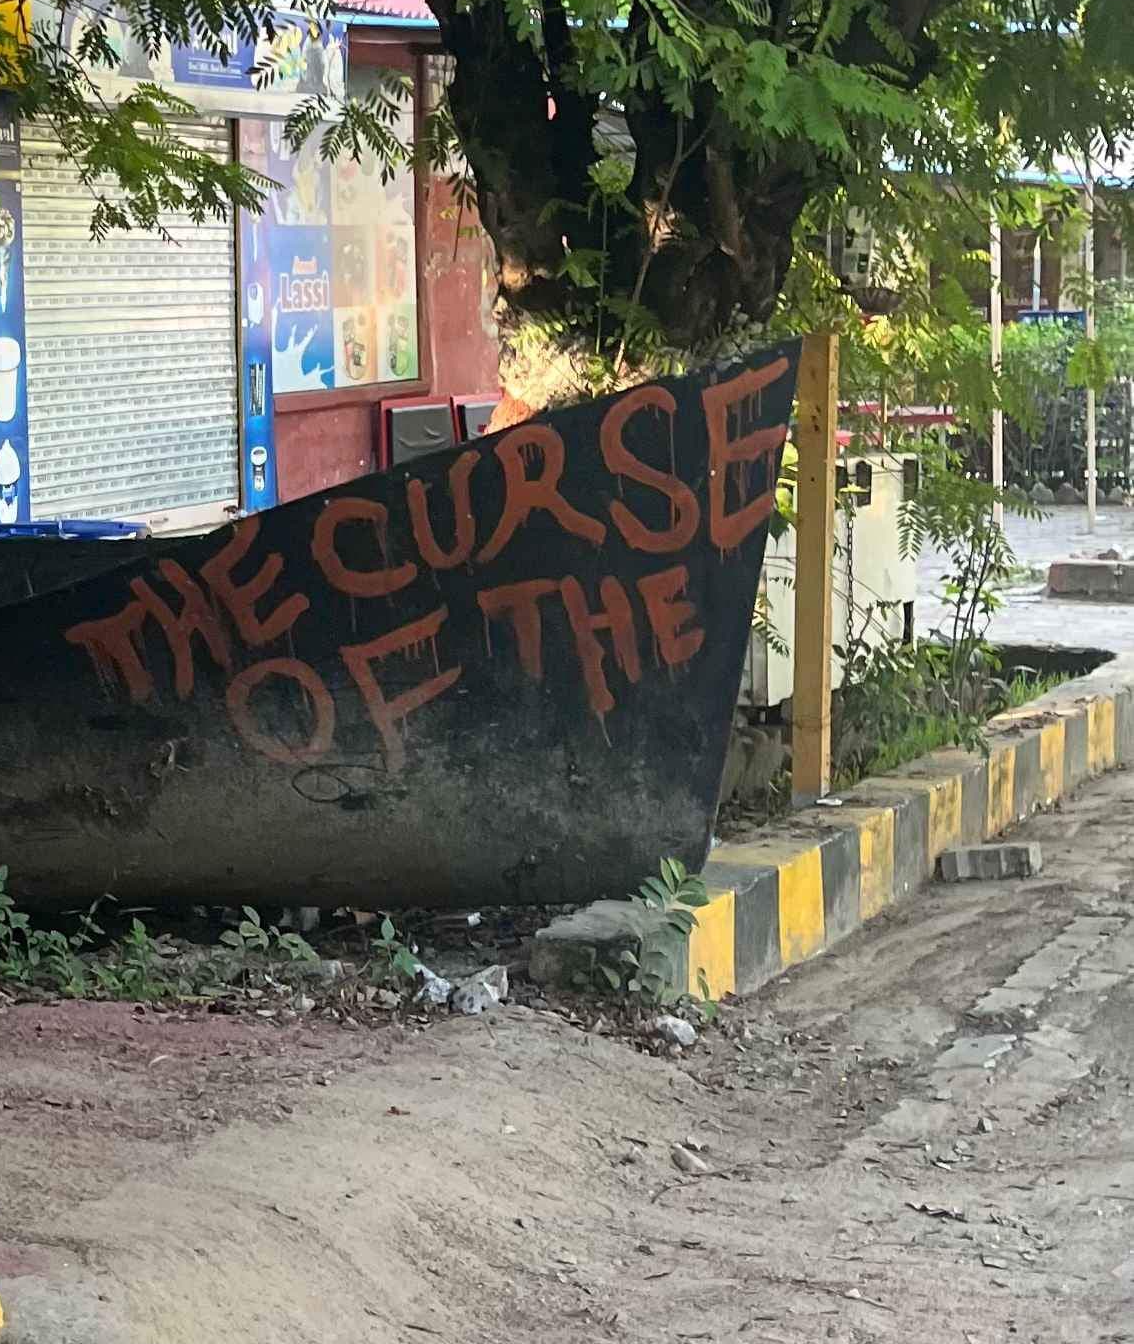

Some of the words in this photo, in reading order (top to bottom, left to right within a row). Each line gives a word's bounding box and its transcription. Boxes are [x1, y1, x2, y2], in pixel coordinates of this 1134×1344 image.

[280, 270, 329, 312] Lassi
[65, 516, 309, 706] THE
[311, 357, 789, 598] CURSE
[225, 604, 463, 778] OF
[477, 564, 705, 714] THE
